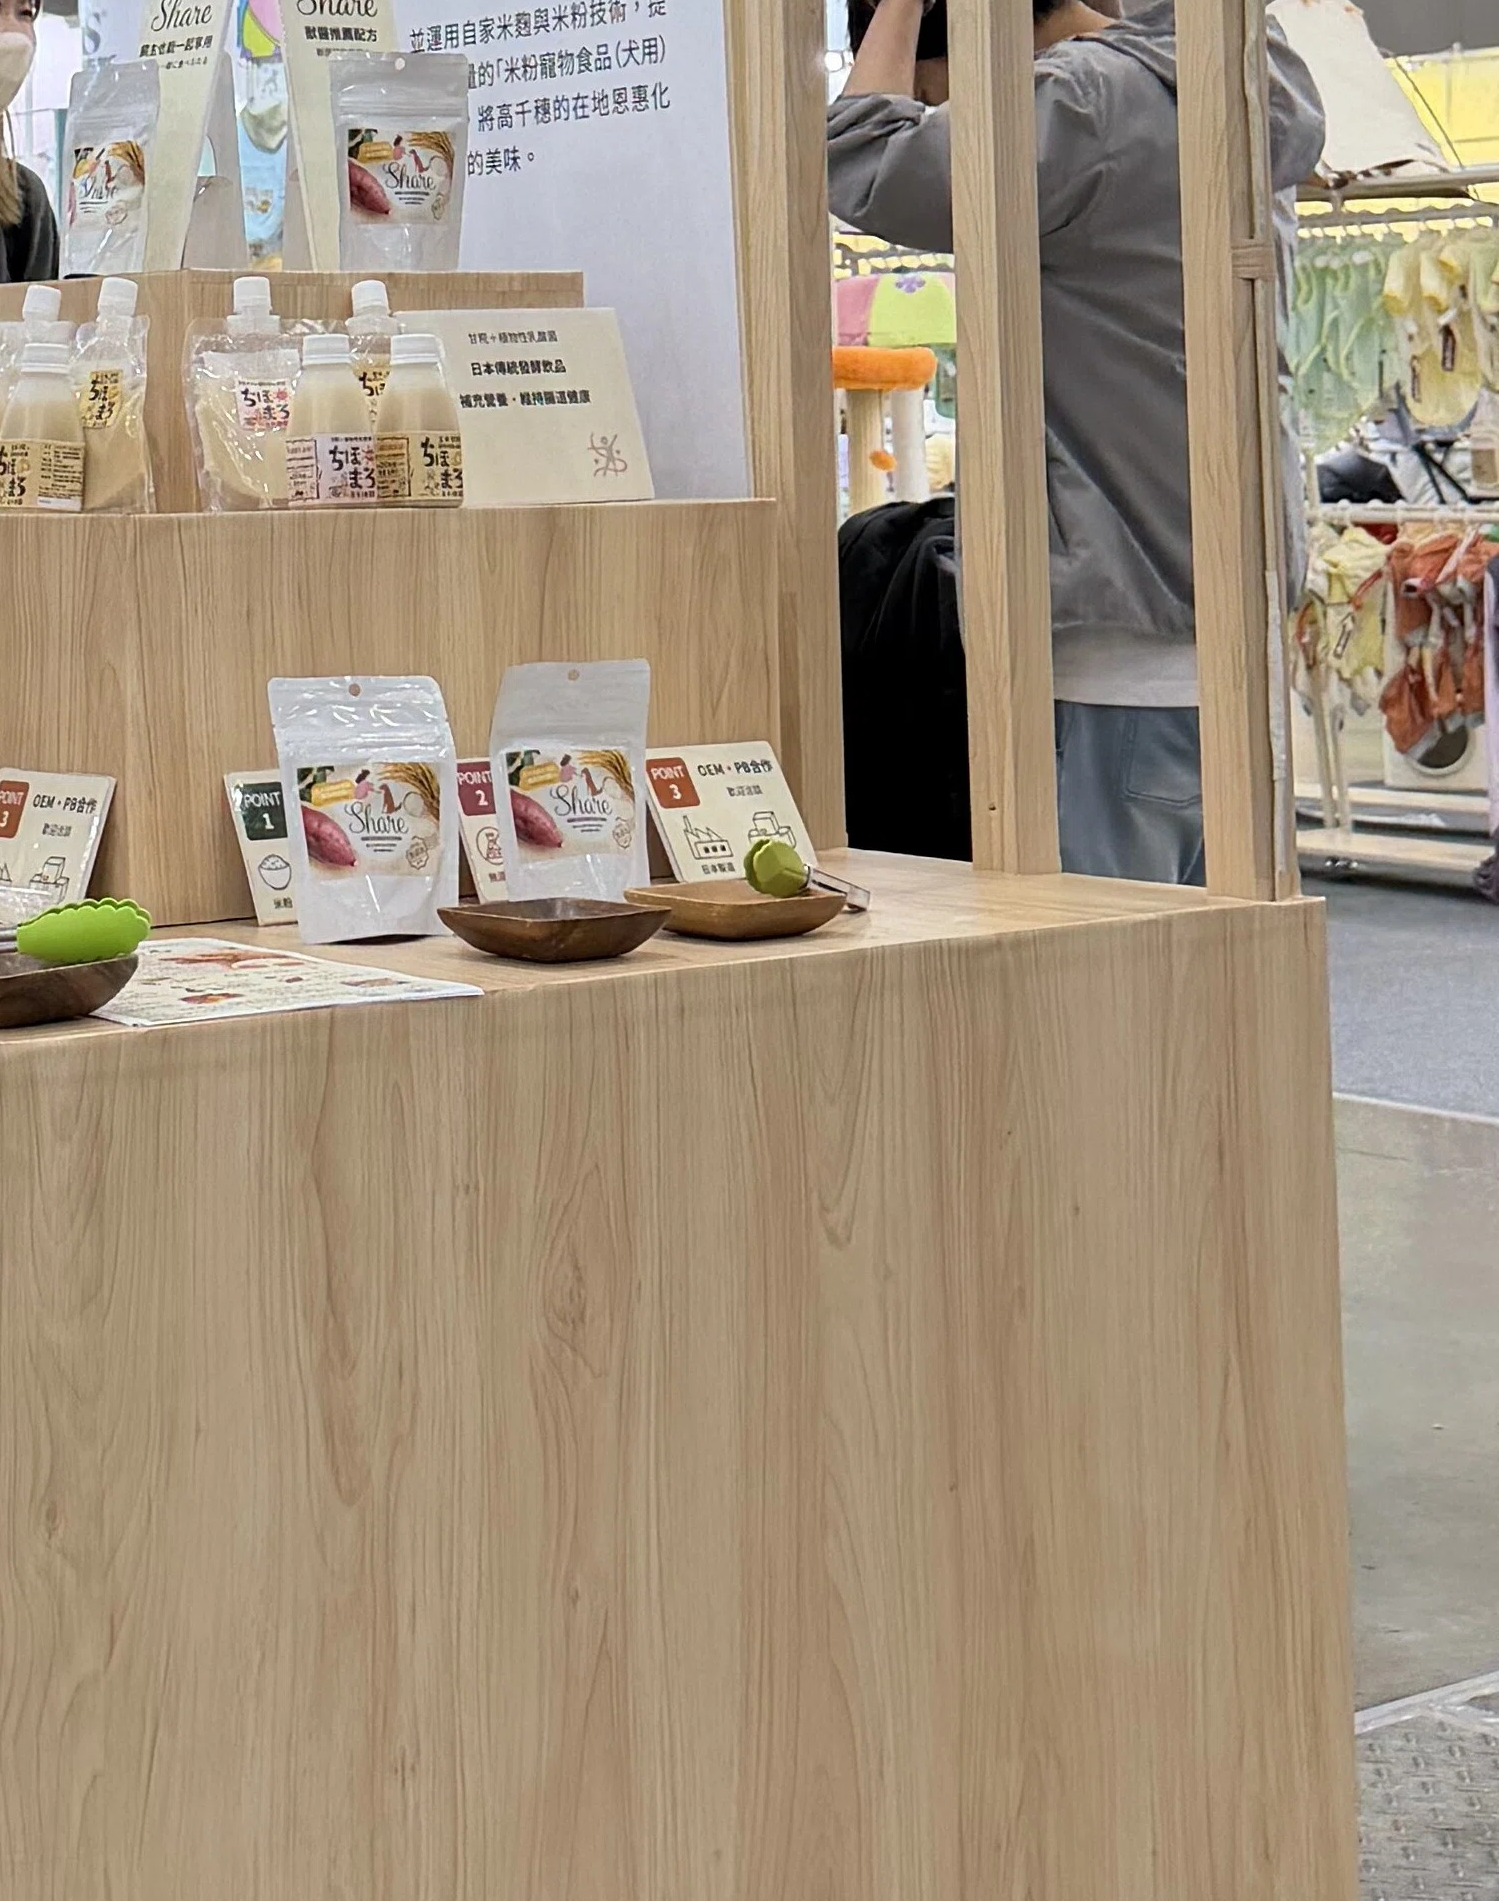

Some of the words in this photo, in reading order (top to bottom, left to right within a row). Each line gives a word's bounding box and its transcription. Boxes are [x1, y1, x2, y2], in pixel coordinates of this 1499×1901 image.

[383, 162, 436, 191] Share
[651, 765, 686, 781] POINT
[243, 791, 281, 808] POINT
[475, 790, 488, 806] 2
[669, 784, 682, 800] 3
[550, 785, 613, 817] Share
[0, 811, 9, 827] 3
[262, 813, 275, 830] 1
[345, 801, 409, 835] Share
